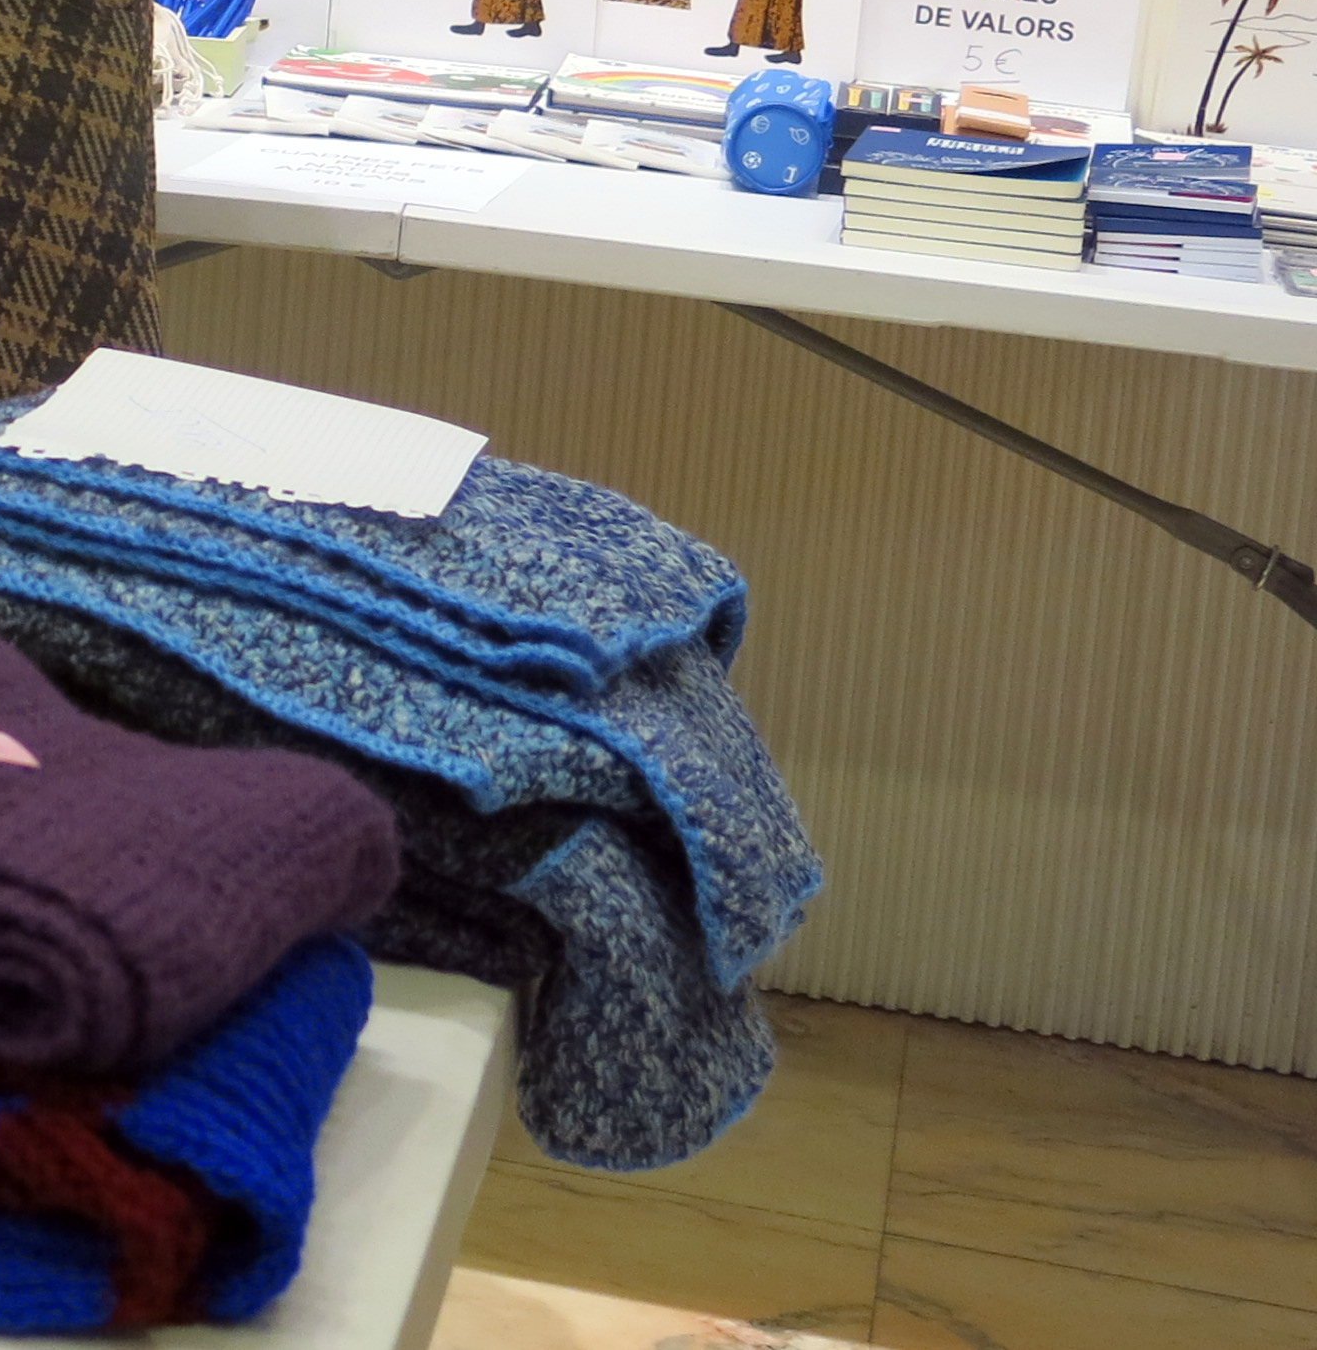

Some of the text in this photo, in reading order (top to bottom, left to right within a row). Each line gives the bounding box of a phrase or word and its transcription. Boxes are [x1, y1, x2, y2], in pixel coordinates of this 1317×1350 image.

[915, 4, 1075, 42] DE VALORS
[962, 44, 1023, 75] 5 €
